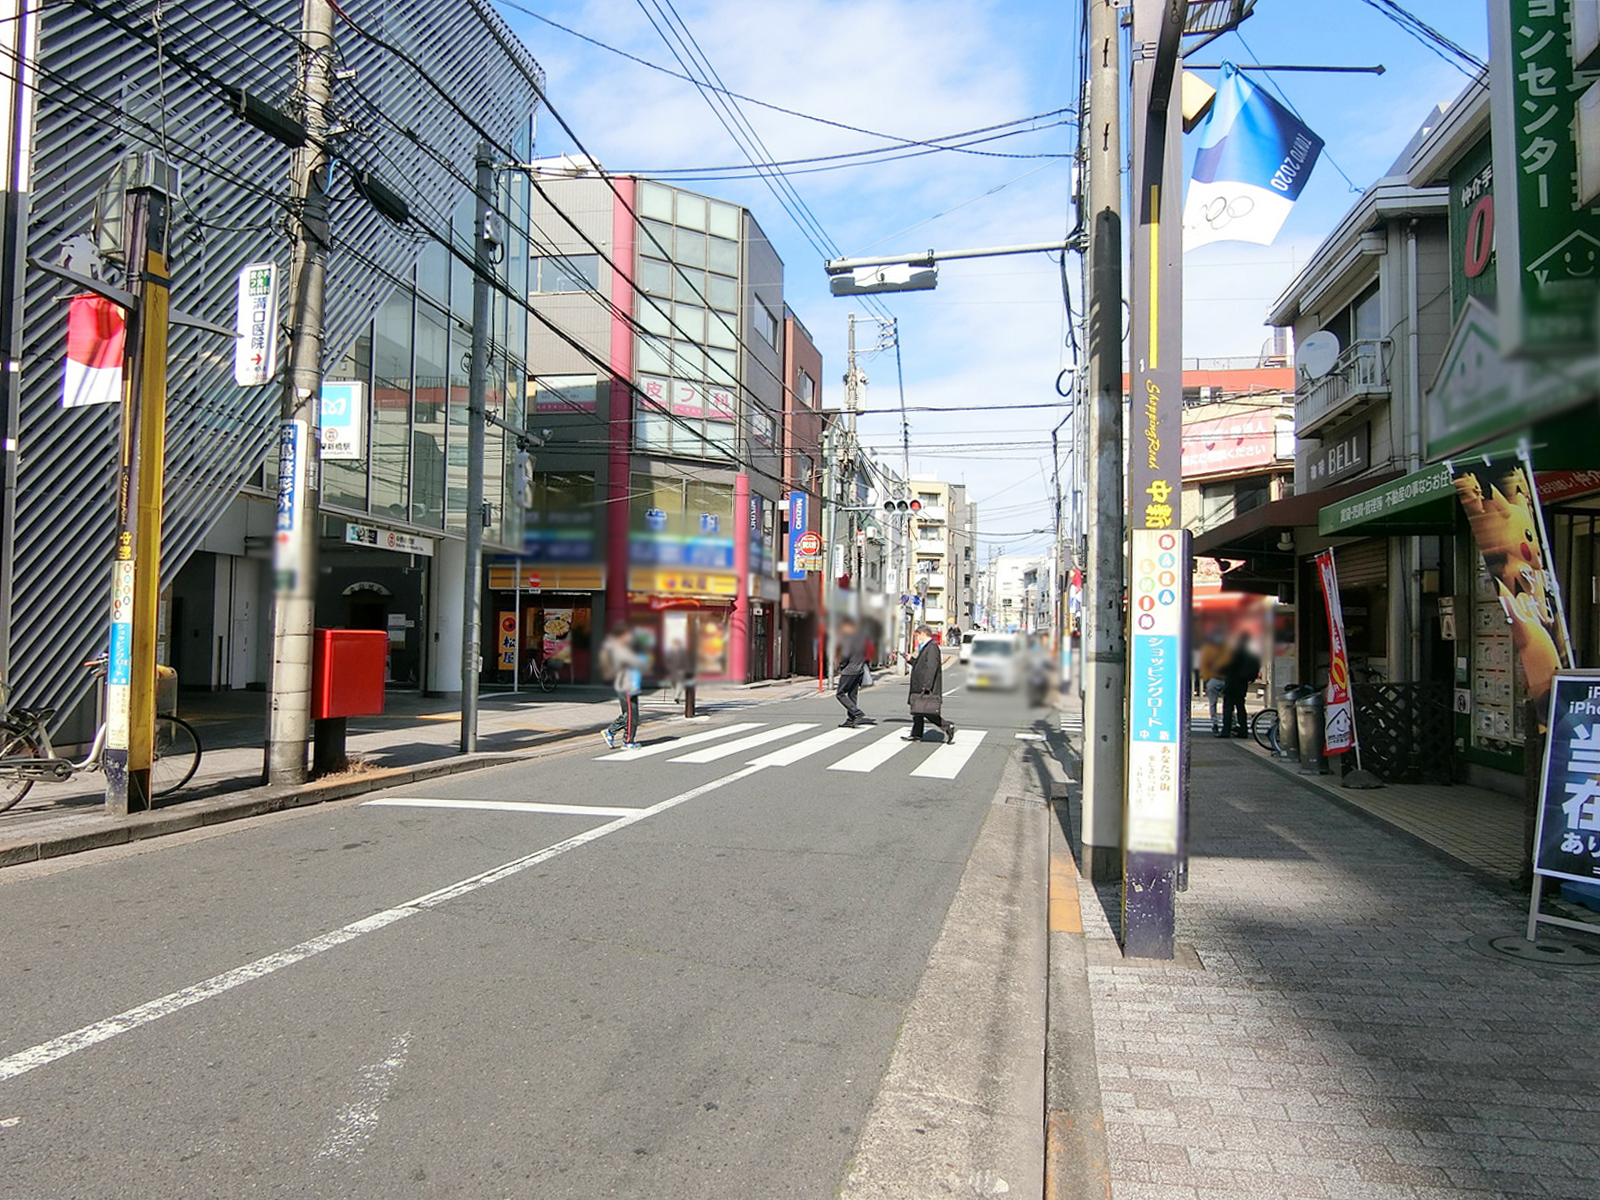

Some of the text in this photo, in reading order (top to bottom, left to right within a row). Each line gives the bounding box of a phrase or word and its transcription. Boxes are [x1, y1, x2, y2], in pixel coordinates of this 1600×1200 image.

[1270, 132, 1312, 192] TOKYO 2020
[251, 297, 266, 349] 溝口医院
[646, 381, 731, 410] 皮フ科
[1328, 436, 1361, 476] BELL
[795, 498, 803, 530] MIZUHO
[1147, 637, 1164, 727] ショッピングロード
